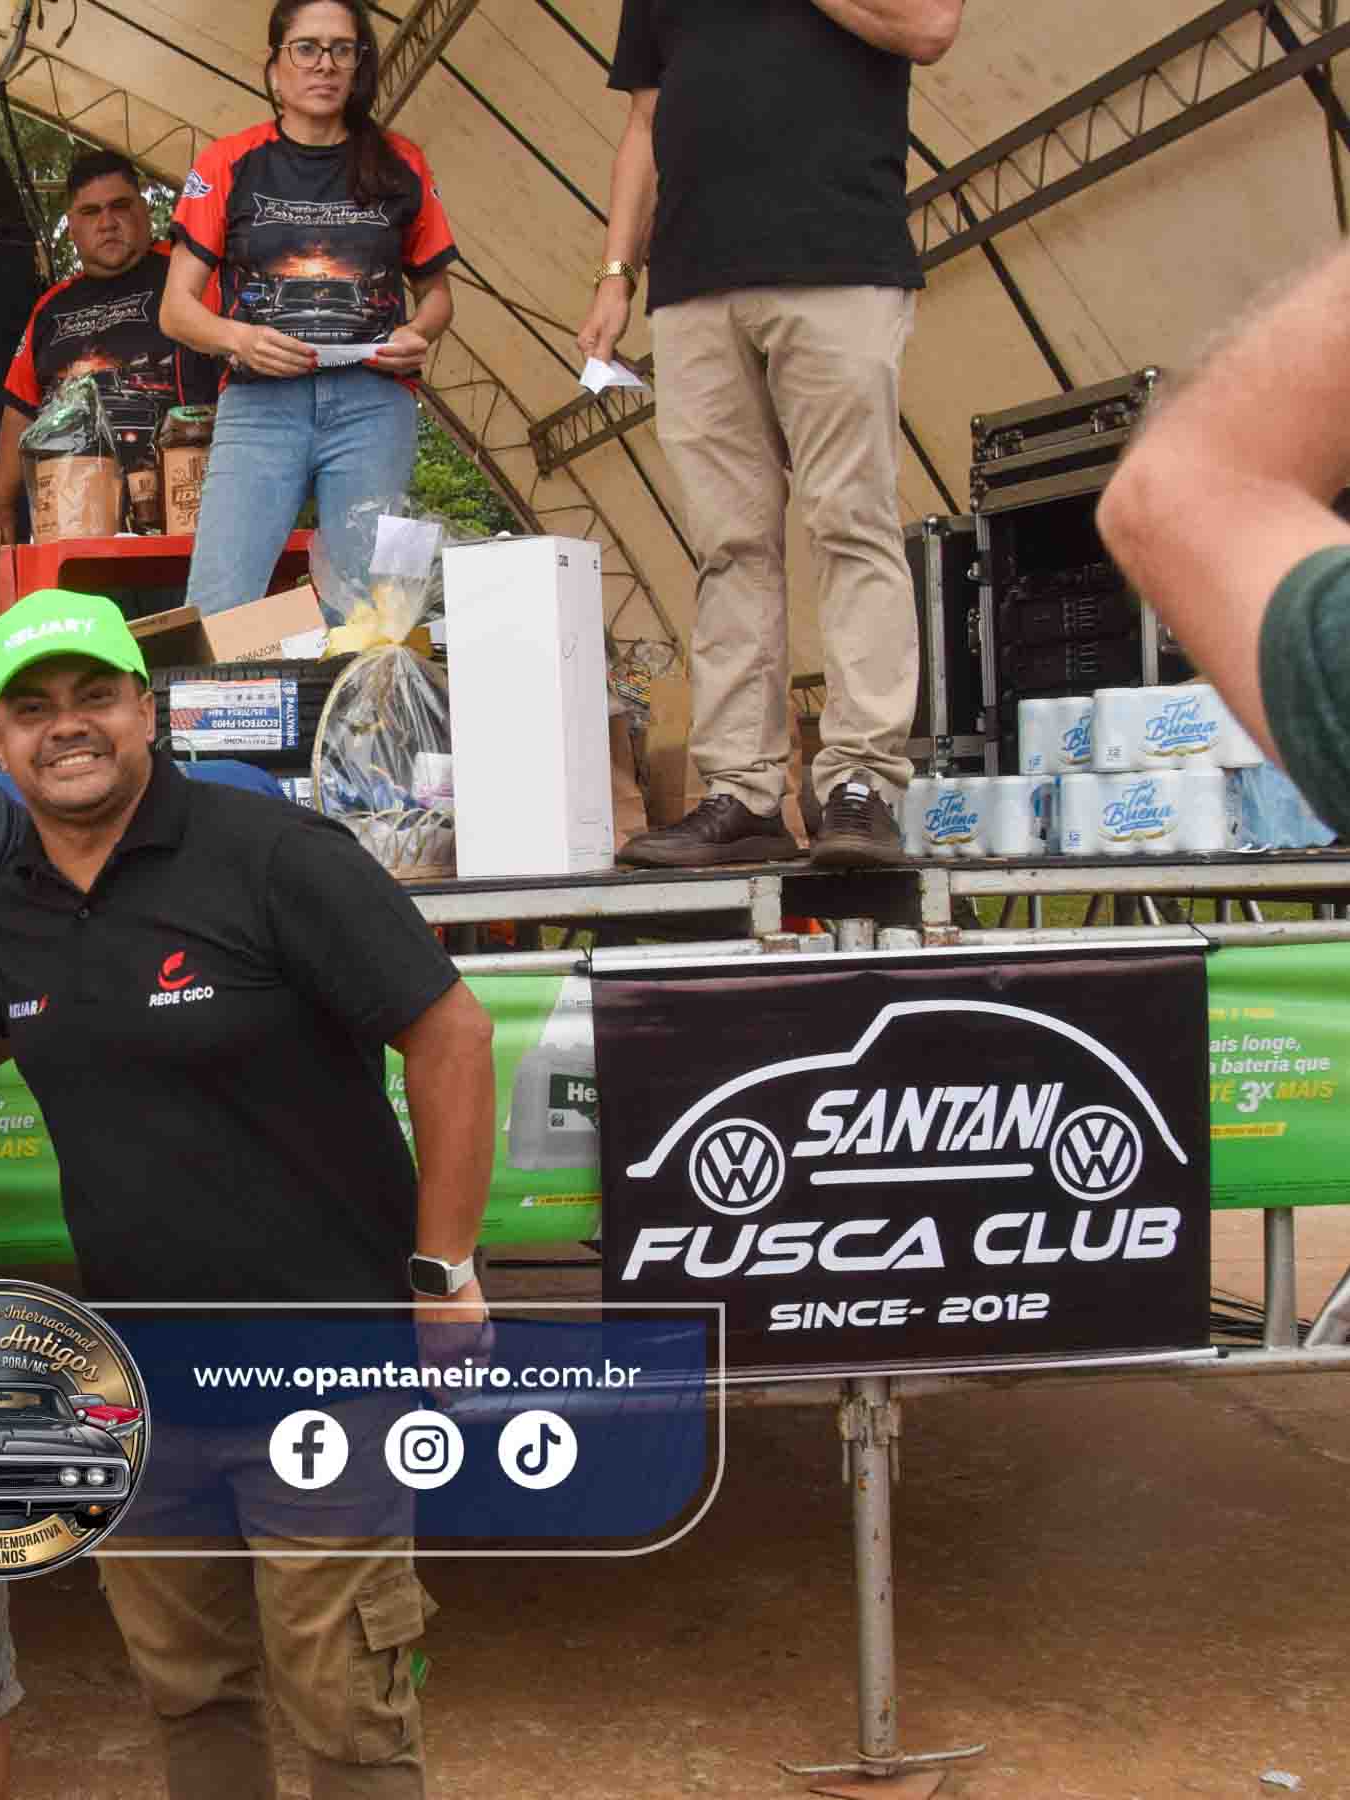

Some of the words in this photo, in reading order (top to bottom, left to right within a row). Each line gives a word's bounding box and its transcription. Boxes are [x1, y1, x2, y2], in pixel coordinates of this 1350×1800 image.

[149, 989, 181, 1008] REDE
[1208, 1034, 1238, 1053] ais
[1221, 1055, 1291, 1074] bateria
[1294, 1055, 1331, 1076] que
[1209, 1078, 1236, 1104] TÉ
[1276, 1081, 1335, 1102] MAIS
[621, 1216, 945, 1281] FUSCA
[973, 1207, 1182, 1265] CLUB
[938, 1293, 1050, 1324] 2012
